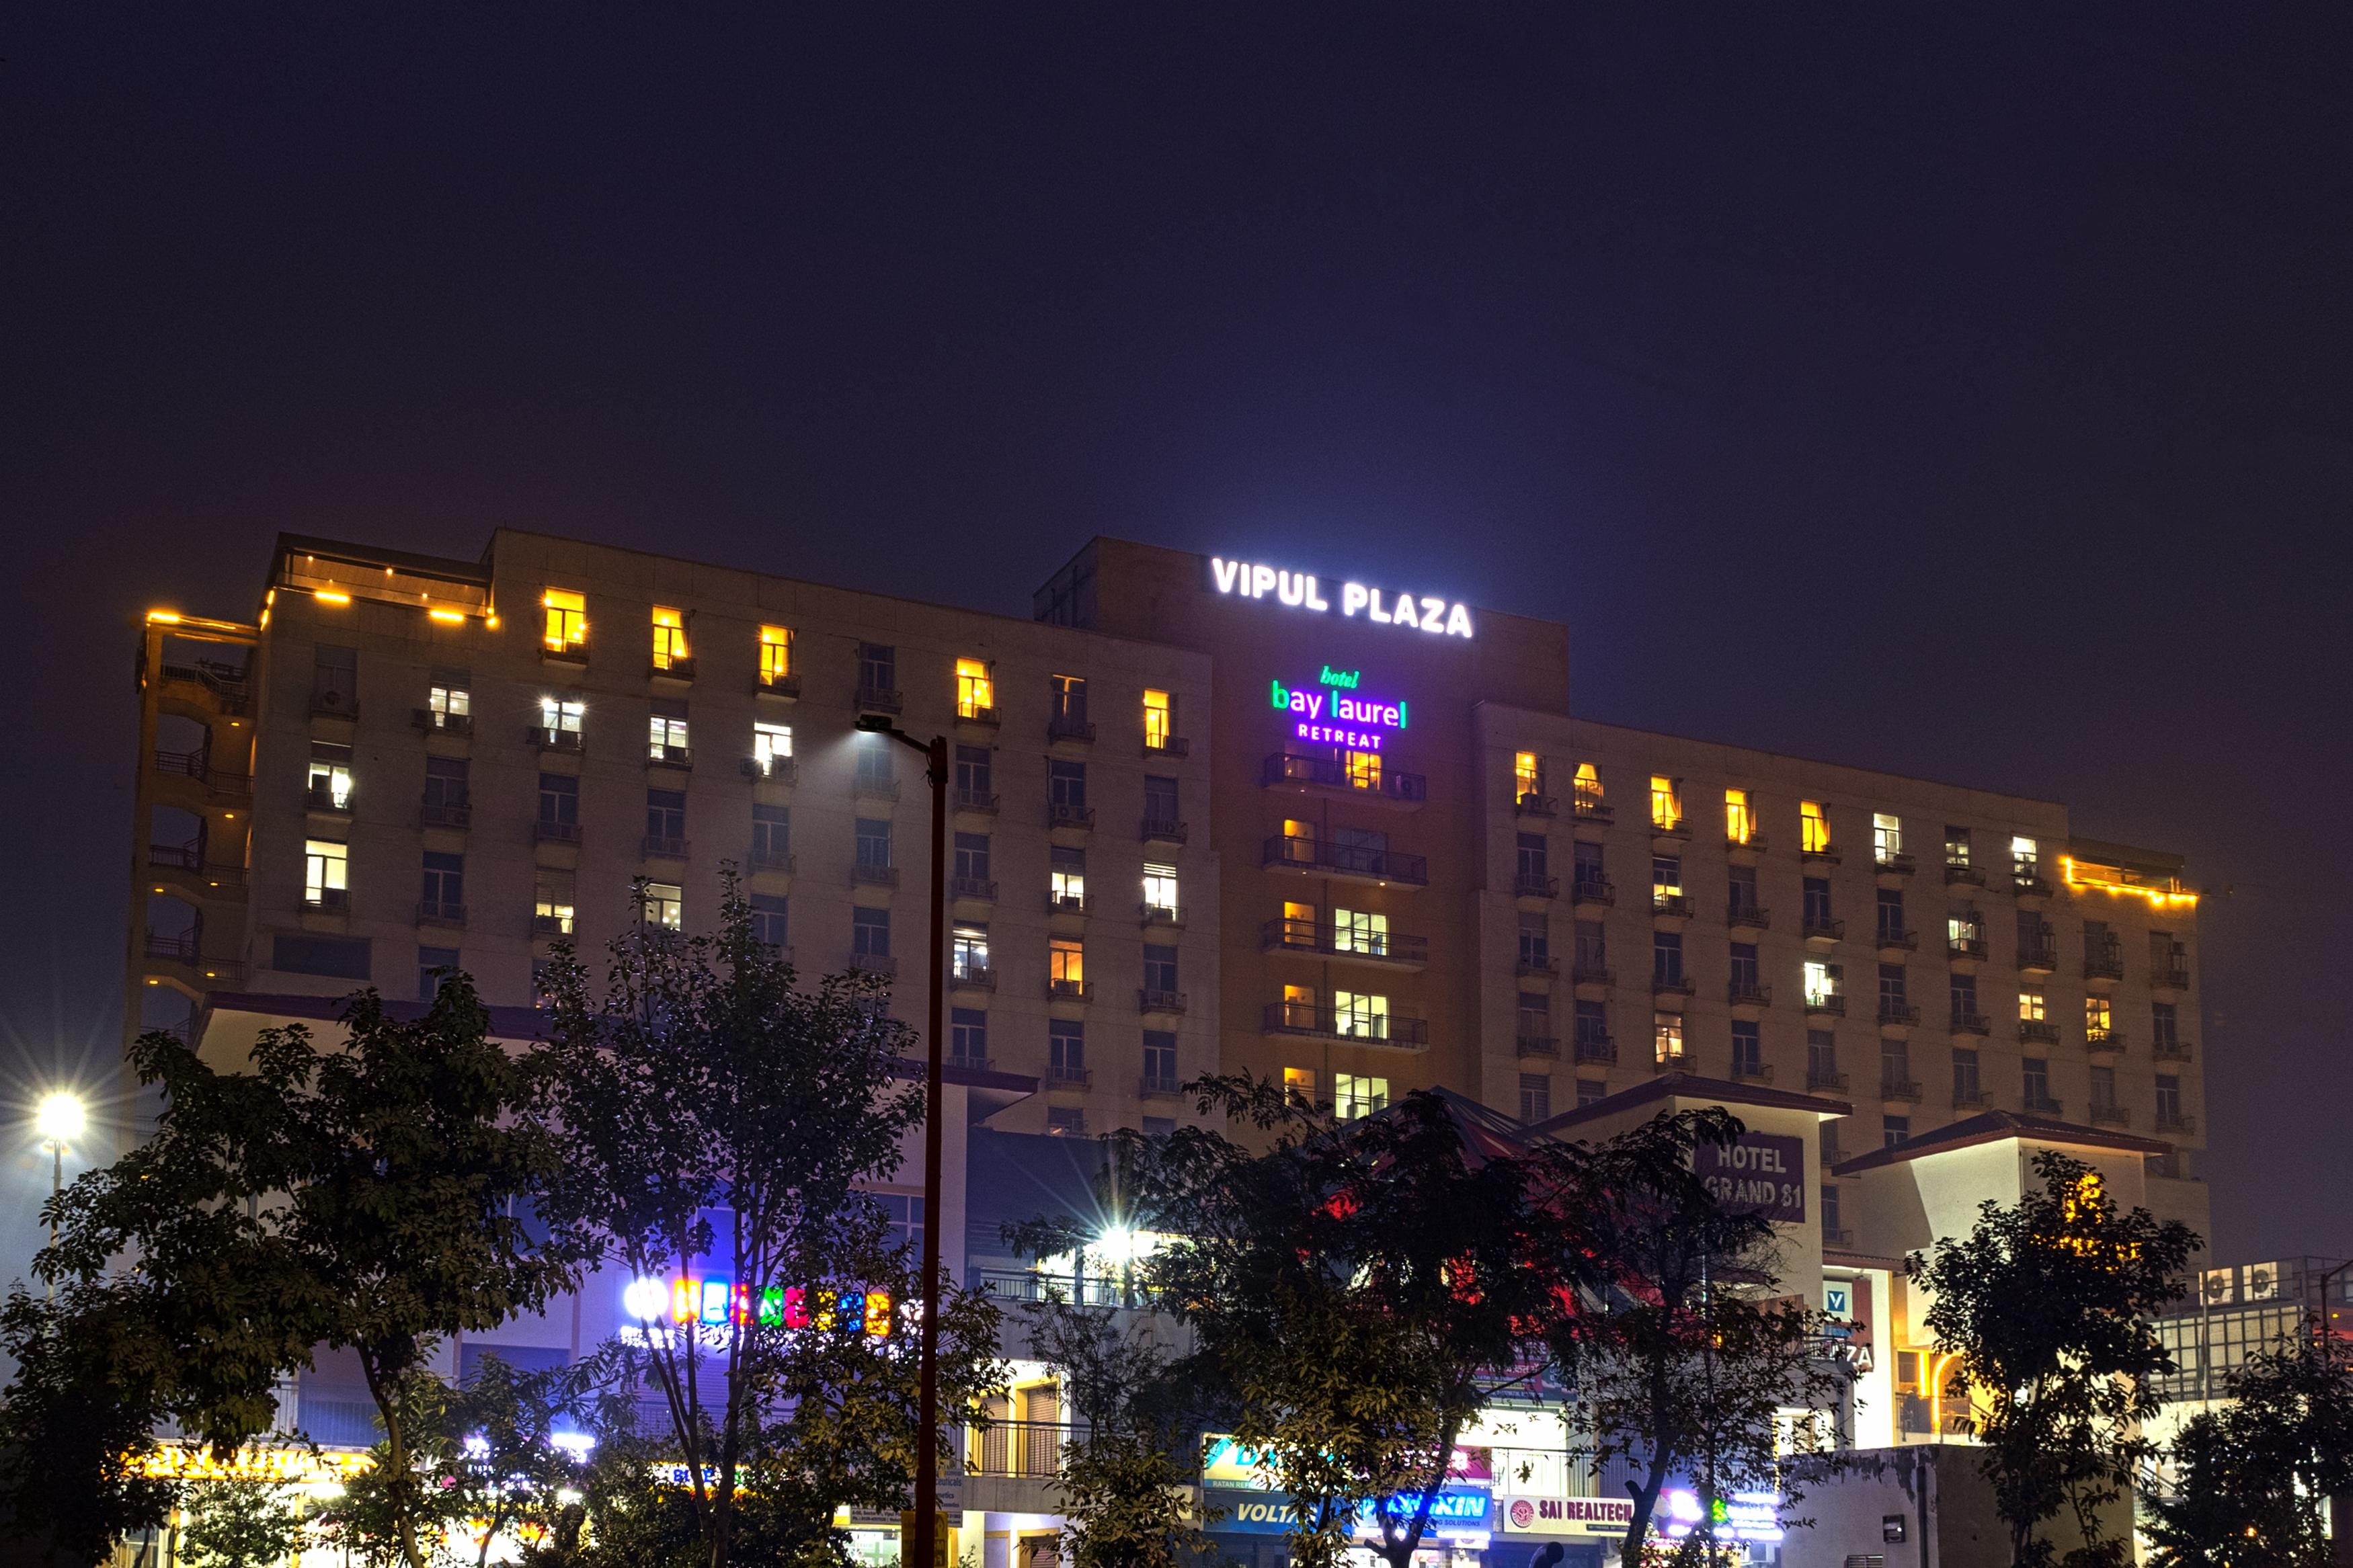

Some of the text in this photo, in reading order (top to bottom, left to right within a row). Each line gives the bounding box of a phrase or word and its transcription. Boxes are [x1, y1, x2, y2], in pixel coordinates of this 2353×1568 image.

[1212, 558, 1472, 638] VIPUL PLAZA
[1272, 679, 1407, 729] bay laurel
[1298, 723, 1381, 749] RETREAT
[1718, 1144, 1787, 1173] HOTEL
[1704, 1175, 1802, 1208] GRAND 81
[673, 1469, 714, 1483] BLE
[1445, 1519, 1481, 1527] SOLUTIONS
[1539, 1499, 1563, 1520] SAI
[1566, 1501, 1632, 1522] REALTECH
